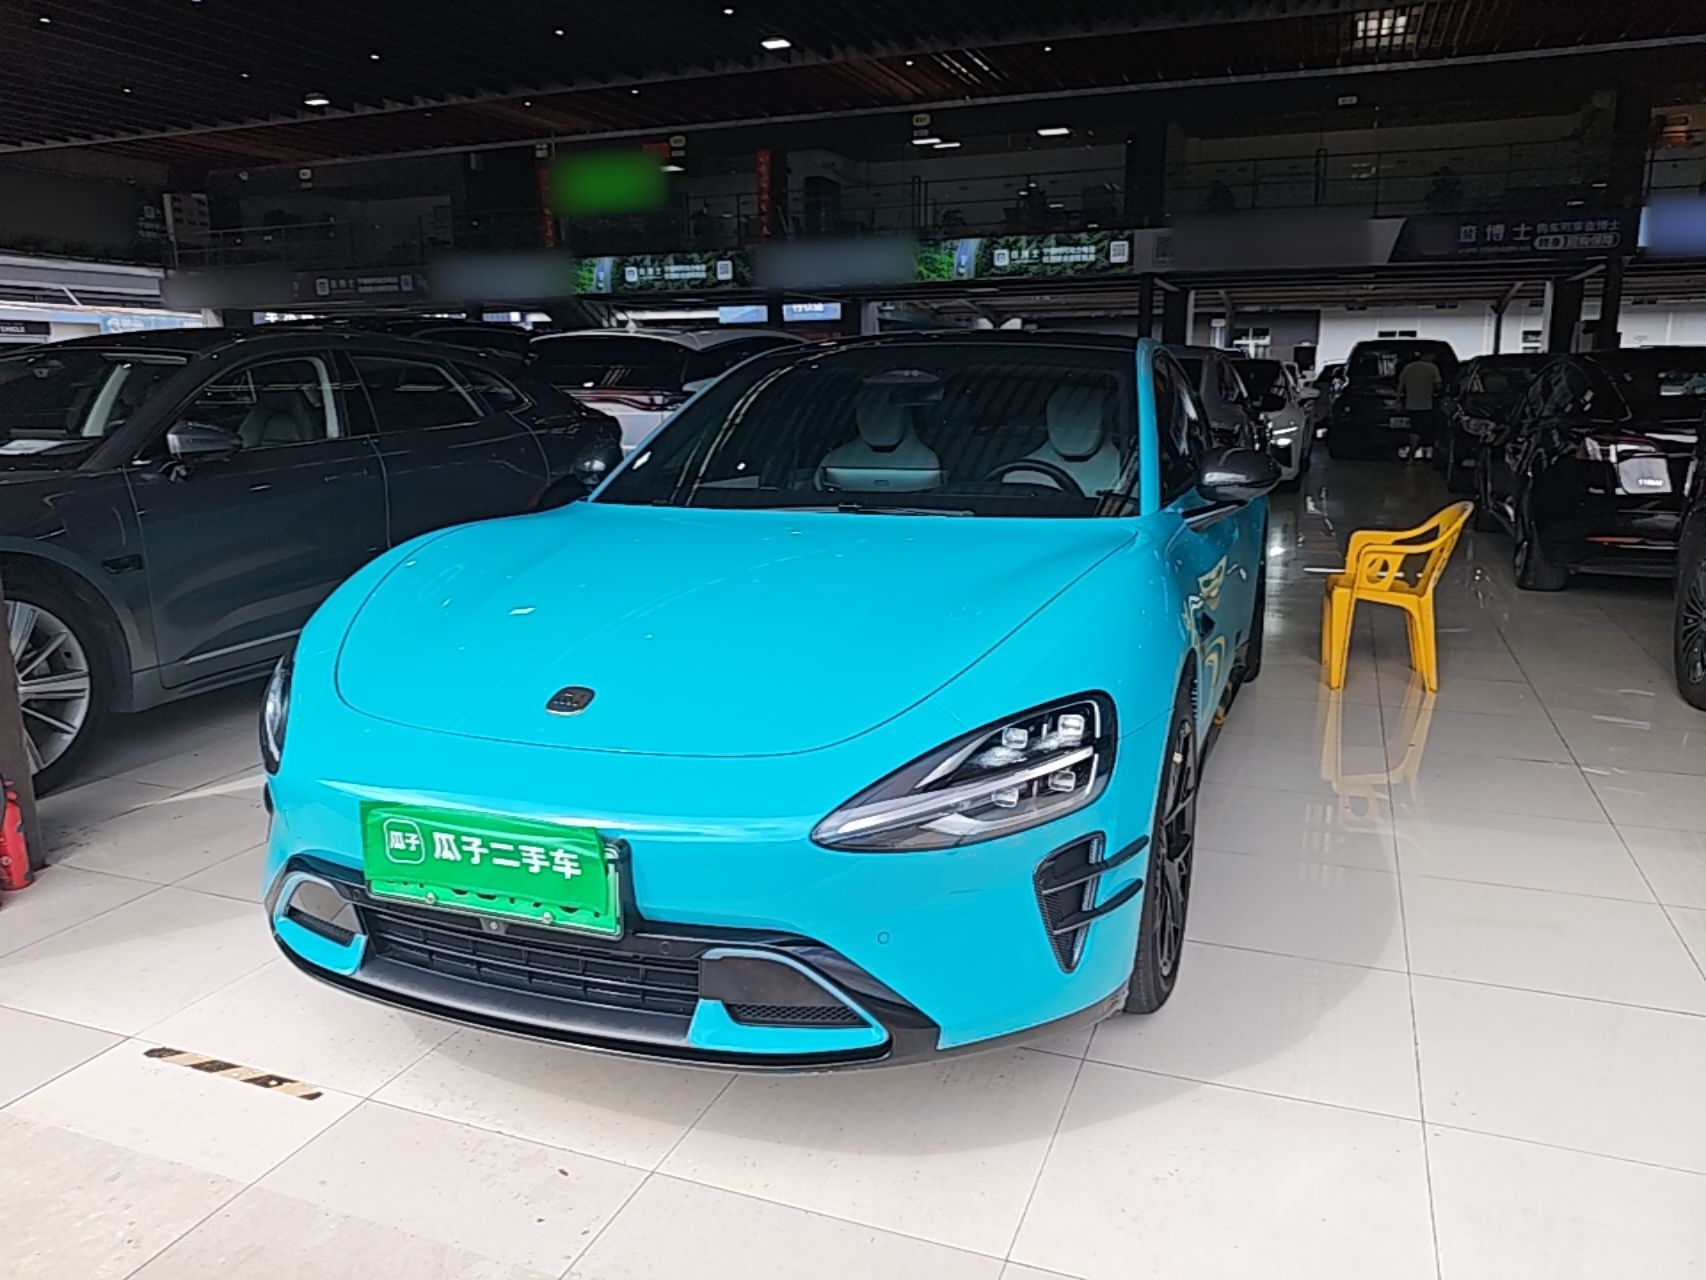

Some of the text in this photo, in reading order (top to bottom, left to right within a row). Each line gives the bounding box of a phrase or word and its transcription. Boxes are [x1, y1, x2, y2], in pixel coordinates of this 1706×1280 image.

[389, 831, 421, 851] 瓜子
[432, 831, 582, 879] 瓜子二手车
